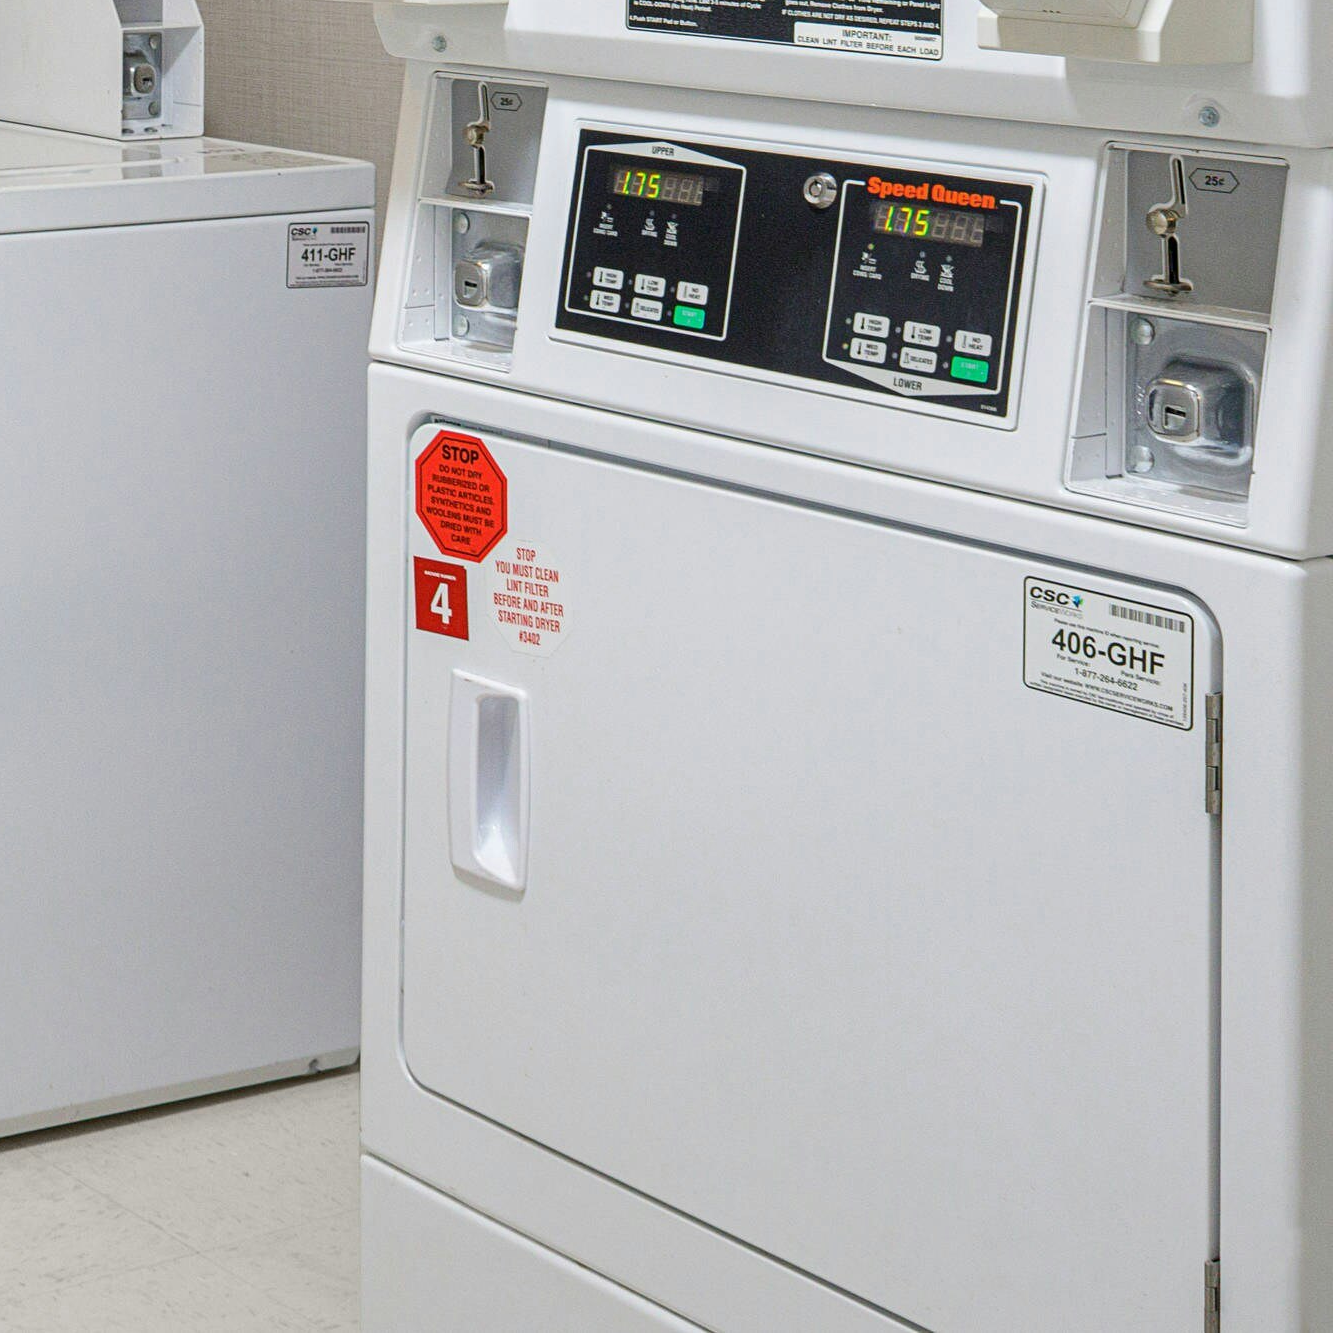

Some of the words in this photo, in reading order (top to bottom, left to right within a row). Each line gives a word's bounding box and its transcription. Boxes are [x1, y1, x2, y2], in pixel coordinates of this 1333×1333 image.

[842, 29, 892, 41] IMPORTANT:
[797, 36, 819, 44] CLEAN
[841, 40, 862, 48] FILTER
[866, 42, 894, 51] BEFORE
[897, 45, 916, 54] EACH
[920, 47, 939, 56] LOAD
[652, 146, 675, 156] UPPER
[867, 176, 929, 200] Speed
[932, 184, 996, 209] Queen
[301, 247, 356, 262] 411-GHF
[867, 325, 882, 333] TEMP
[919, 327, 932, 335] LOW
[968, 343, 983, 351] HEAT
[910, 355, 933, 365] DELICATES
[893, 377, 922, 391] LOWER
[442, 444, 479, 464] STOP
[439, 464, 449, 473] DO
[452, 467, 465, 475] NOT
[468, 470, 482, 479] DRY
[428, 484, 456, 497] PLASTIC
[432, 474, 477, 490] RUBBERIZED
[479, 484, 490, 492] OR
[431, 497, 474, 512] SYNTHETICS
[476, 506, 491, 515] AND
[427, 507, 461, 520] WOOLENS
[463, 514, 482, 525] MUST
[485, 519, 494, 528] BE
[441, 521, 461, 531] DRIED
[464, 526, 481, 535] WITH
[451, 534, 470, 545] CARE
[516, 547, 536, 563] STOP
[495, 561, 510, 574] YOU
[513, 564, 533, 579] MUST
[536, 567, 559, 583] CLEAN
[507, 579, 522, 592] LINT
[525, 582, 549, 597] FILTER
[1030, 587, 1069, 605] CSC
[431, 583, 452, 624] 4
[494, 593, 521, 609] BEFORE
[523, 598, 538, 611] AND
[541, 602, 563, 617] AFTER
[498, 610, 533, 628] STARTING
[536, 616, 560, 632] DRYER
[519, 632, 541, 646] #3402
[1052, 628, 1165, 675] 406-GHF
